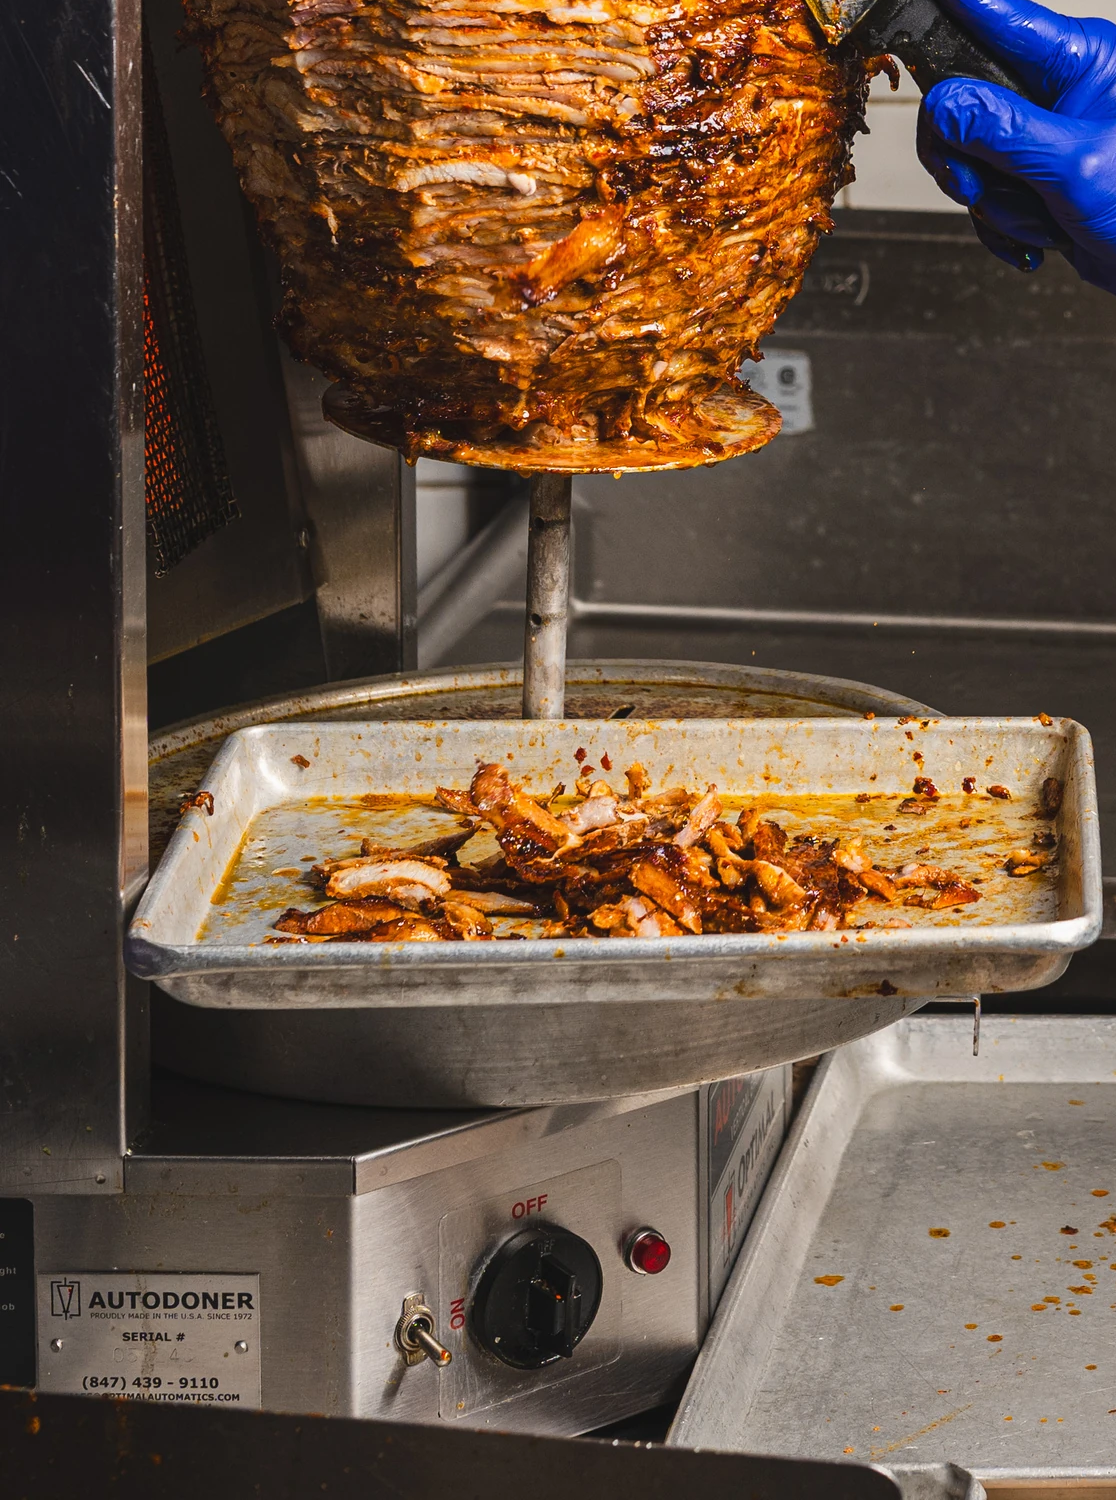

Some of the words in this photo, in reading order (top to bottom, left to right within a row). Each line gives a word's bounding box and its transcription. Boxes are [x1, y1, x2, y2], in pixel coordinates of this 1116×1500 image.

[511, 1193, 548, 1220] OFF
[88, 1291, 255, 1310] AUTODONER
[90, 1312, 126, 1320] PROUDLY
[128, 1312, 150, 1320] MADE
[152, 1312, 162, 1320] IN
[164, 1312, 178, 1320] THE
[180, 1312, 204, 1320] U.S.A.
[207, 1312, 231, 1320] SINCE
[233, 1312, 253, 1320] 1972
[450, 1297, 465, 1330] ON
[122, 1332, 171, 1342] SERIAL
[176, 1332, 186, 1342] #
[82, 1375, 127, 1391] (847)
[132, 1377, 162, 1389] 439
[179, 1377, 219, 1389] 9110
